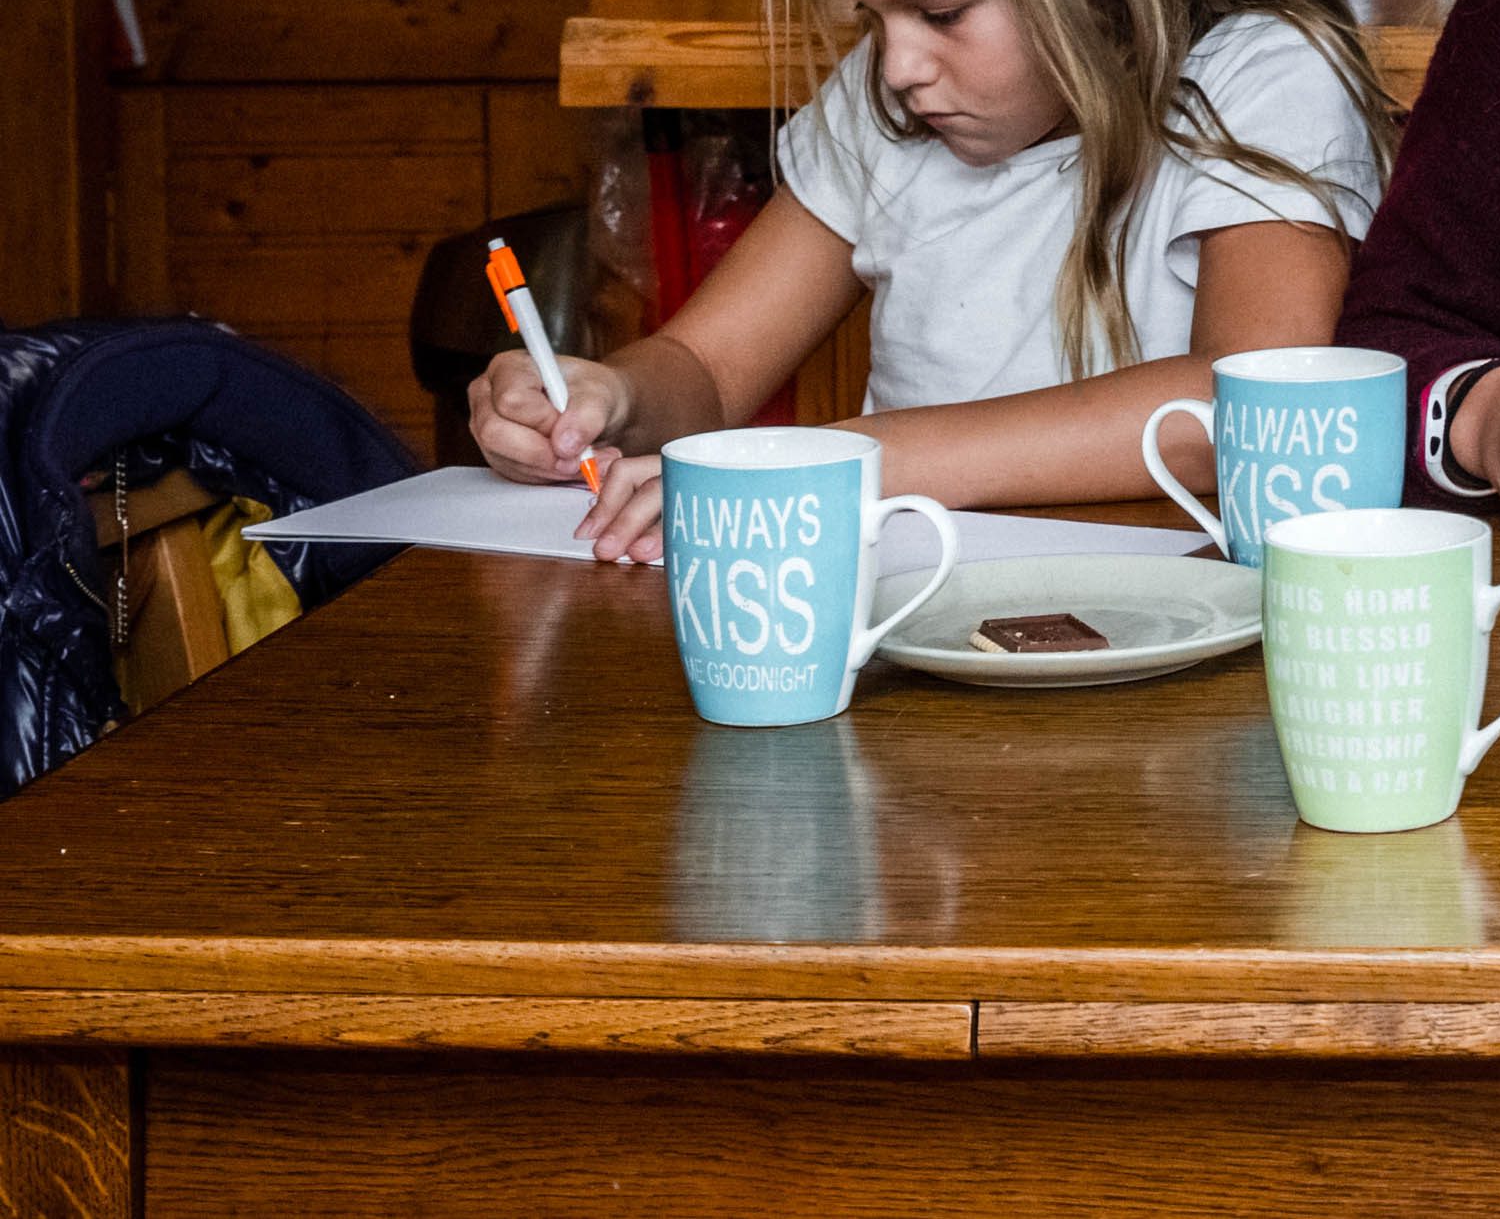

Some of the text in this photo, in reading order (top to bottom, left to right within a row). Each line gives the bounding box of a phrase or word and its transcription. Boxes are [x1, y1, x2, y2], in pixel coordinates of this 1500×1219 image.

[1222, 401, 1358, 455] ALWAYS
[672, 492, 821, 549] ALWAYS
[673, 552, 815, 656] KISS
[1269, 579, 1432, 615] THIS HOME
[1306, 621, 1432, 654] BLESSED
[706, 661, 819, 692] GOODNIGHT
[1273, 655, 1336, 688] WITH
